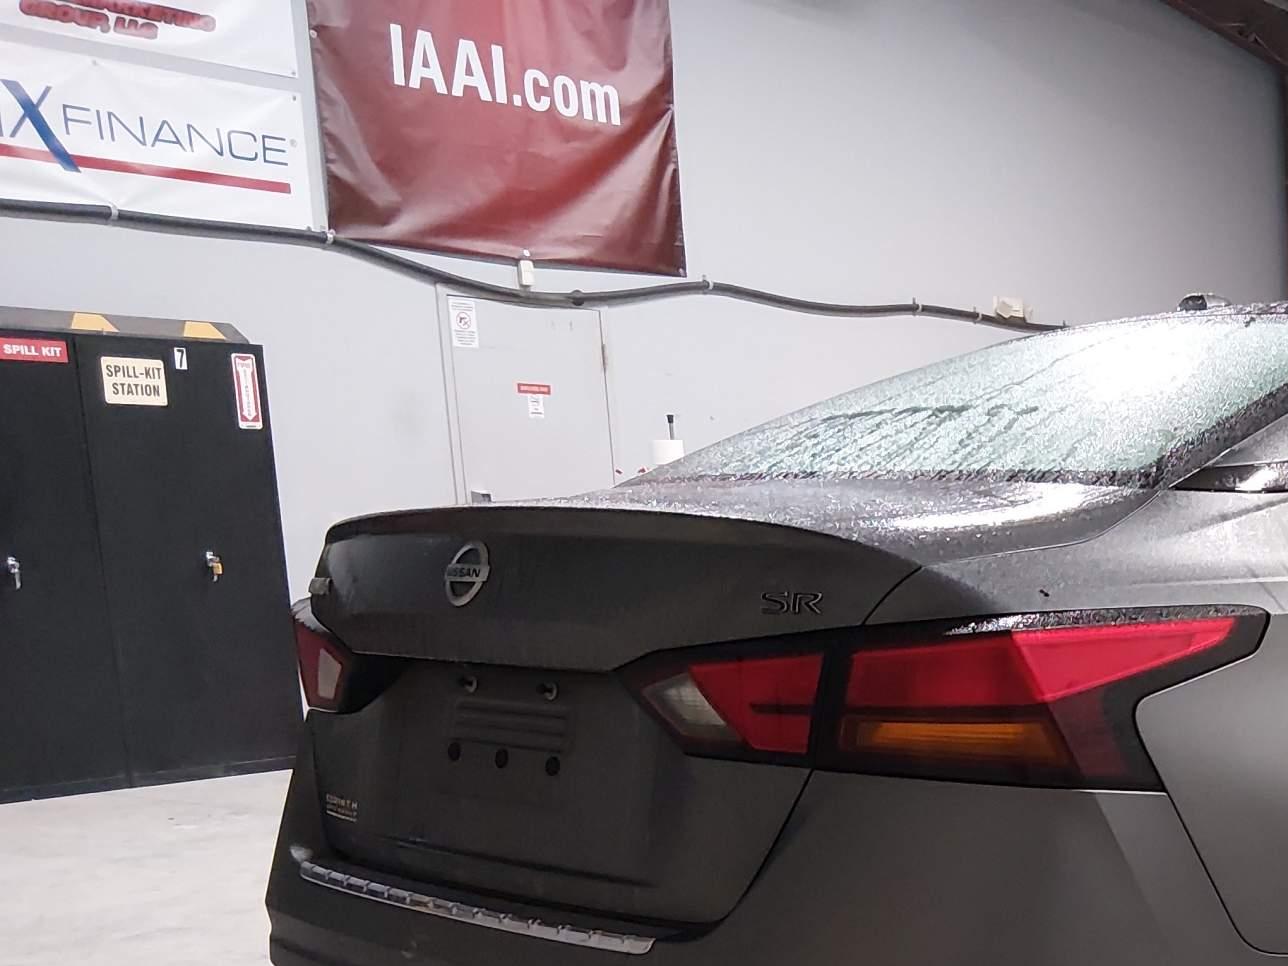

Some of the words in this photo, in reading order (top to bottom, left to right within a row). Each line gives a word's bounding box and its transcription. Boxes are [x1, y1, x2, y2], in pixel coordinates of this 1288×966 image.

[389, 22, 622, 127] IAAI.com
[62, 103, 289, 167] FINANCE
[3, 343, 39, 356] SPILL
[41, 344, 61, 357] KIT
[177, 349, 185, 369] 7
[105, 364, 162, 380] SPILL-KIT
[112, 382, 160, 397] STATION
[447, 566, 481, 578] SSAN
[760, 591, 823, 615] SR
